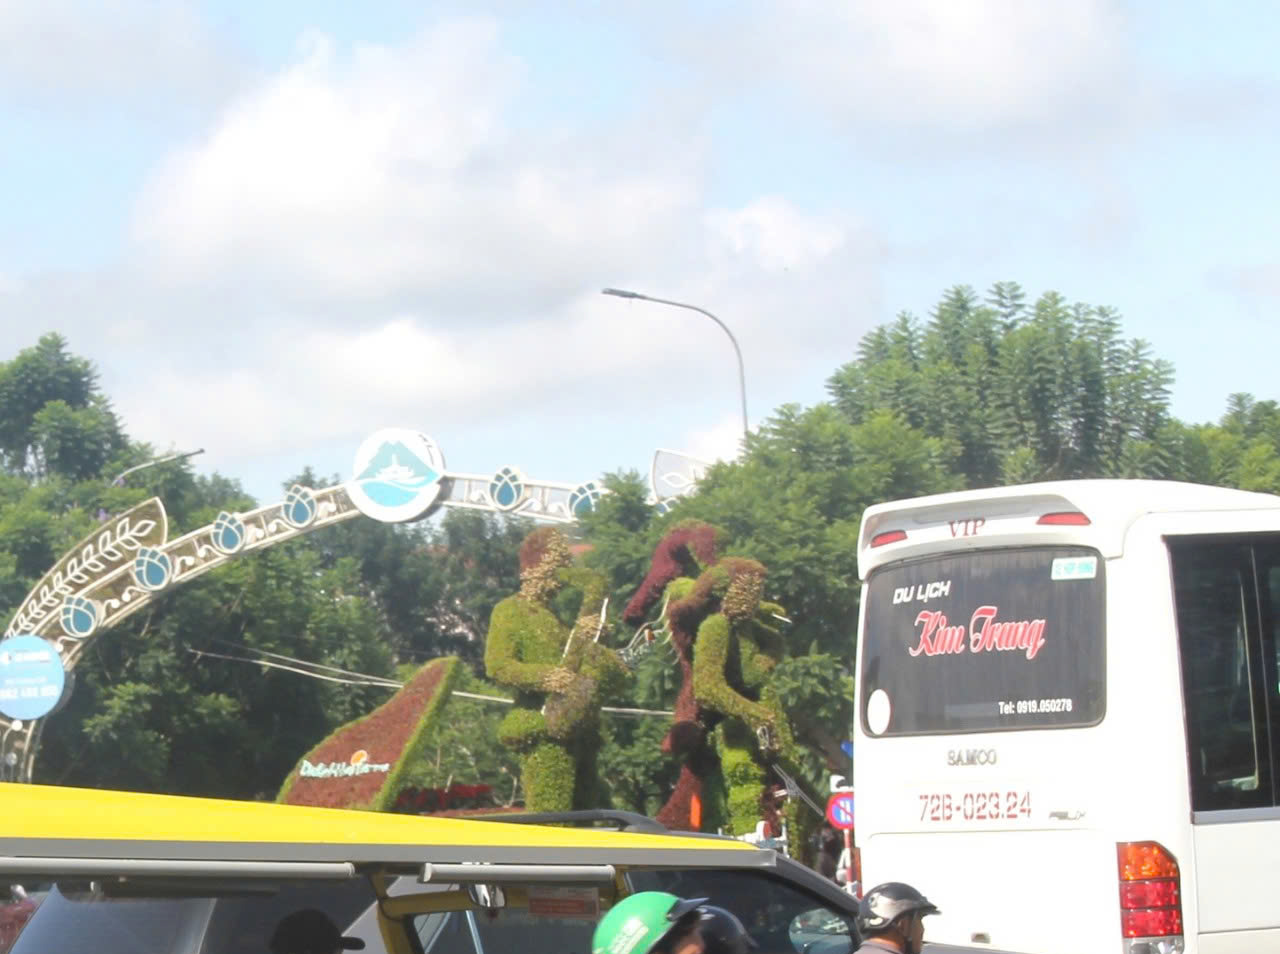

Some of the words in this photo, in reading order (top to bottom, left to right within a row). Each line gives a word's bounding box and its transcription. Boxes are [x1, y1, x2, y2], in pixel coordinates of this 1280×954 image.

[948, 518, 986, 538] VIP
[893, 587, 914, 604] DU
[908, 610, 965, 657] Kim
[970, 605, 1046, 660] Trang
[998, 701, 1015, 715] Tel:
[919, 791, 1032, 821] 72B-023.24
